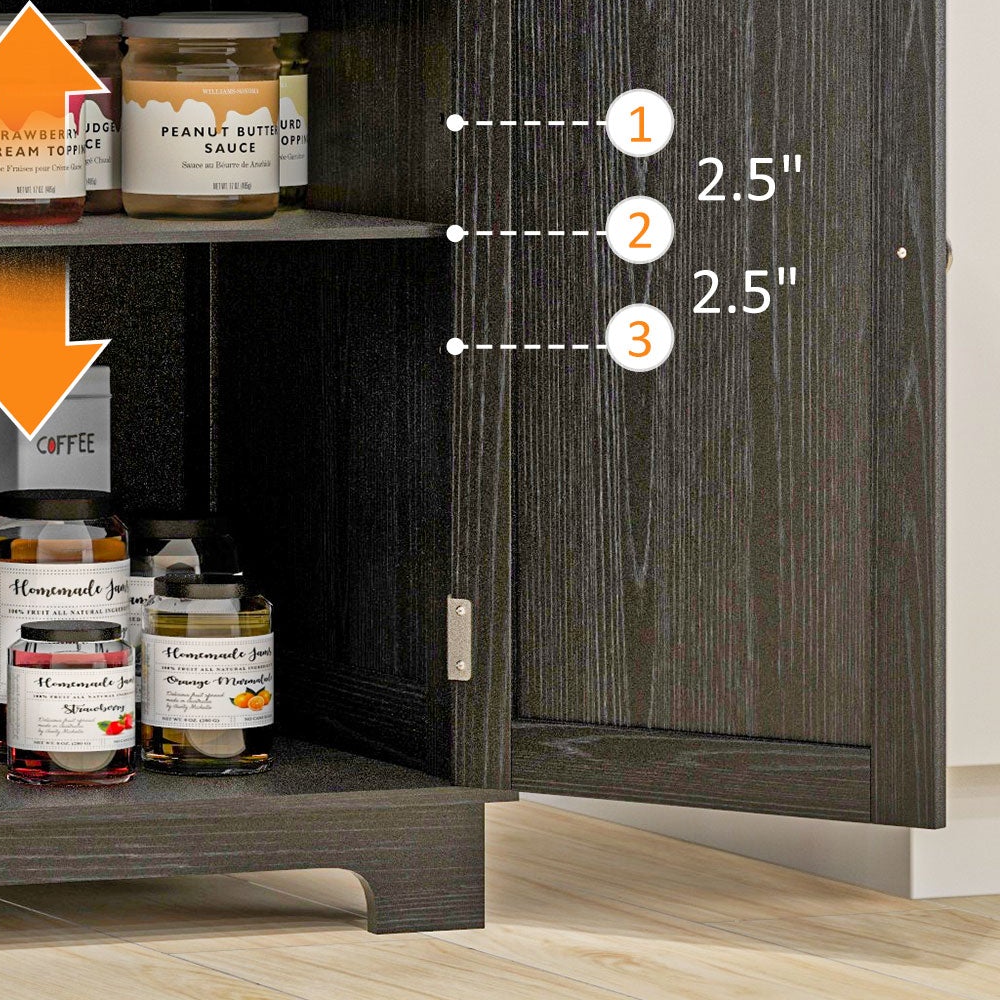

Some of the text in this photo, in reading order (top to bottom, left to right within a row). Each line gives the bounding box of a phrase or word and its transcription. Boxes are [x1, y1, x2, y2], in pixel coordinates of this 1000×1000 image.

[280, 118, 301, 130] URD
[161, 126, 229, 137] PEANUT
[204, 142, 256, 153] SAUCE
[36, 432, 95, 455] COFFEE
[9, 578, 102, 597] Homemade
[162, 647, 246, 660] Homemade
[34, 676, 114, 689] Homemade
[163, 675, 211, 689] Orange
[61, 703, 125, 715] Strawberry
